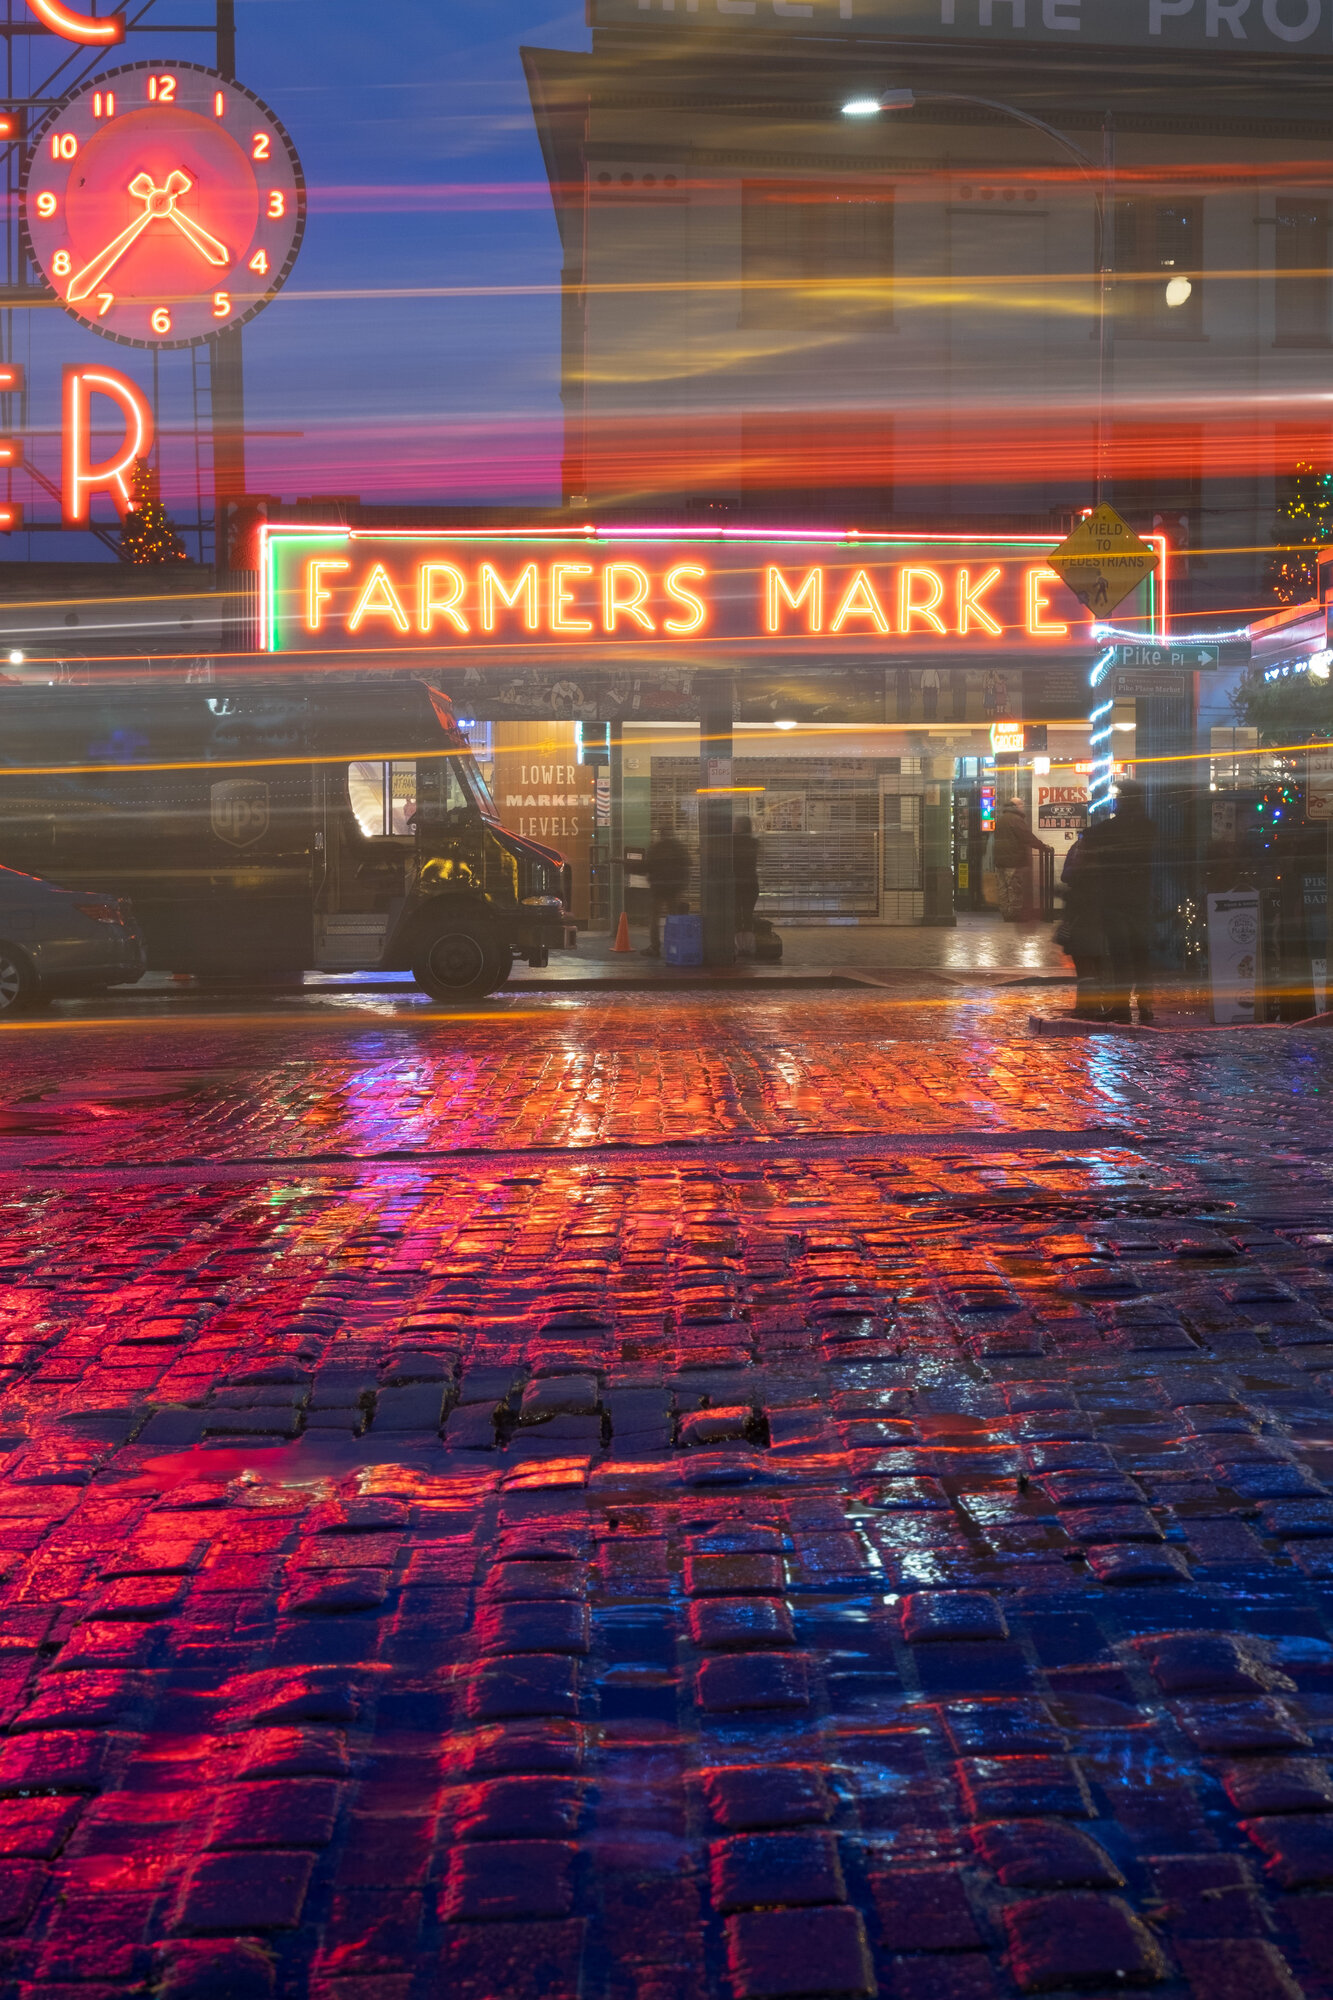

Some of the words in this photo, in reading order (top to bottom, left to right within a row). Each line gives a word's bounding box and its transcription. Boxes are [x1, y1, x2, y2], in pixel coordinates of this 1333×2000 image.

[147, 74, 177, 102] 12
[93, 91, 115, 117] 11
[214, 91, 224, 117] 1
[51, 133, 78, 160] 10
[252, 133, 270, 159] 2
[36, 192, 56, 217] 9
[266, 191, 285, 218] 3
[52, 250, 71, 276] 8
[248, 250, 268, 275] 4
[96, 293, 114, 316] 7
[213, 293, 231, 317] 5
[150, 307, 171, 334] 6
[1086, 523, 1123, 536] YIELD
[1096, 539, 1112, 551] TO
[1061, 554, 1145, 569] PEDESTRIANS
[307, 560, 706, 631] FARMERS
[1123, 646, 1161, 665] Pike
[521, 765, 576, 785] LOWER
[505, 794, 592, 807] MARKET
[1038, 786, 1088, 805] PIKES
[215, 800, 266, 837] ups
[519, 816, 579, 837] LEVELS
